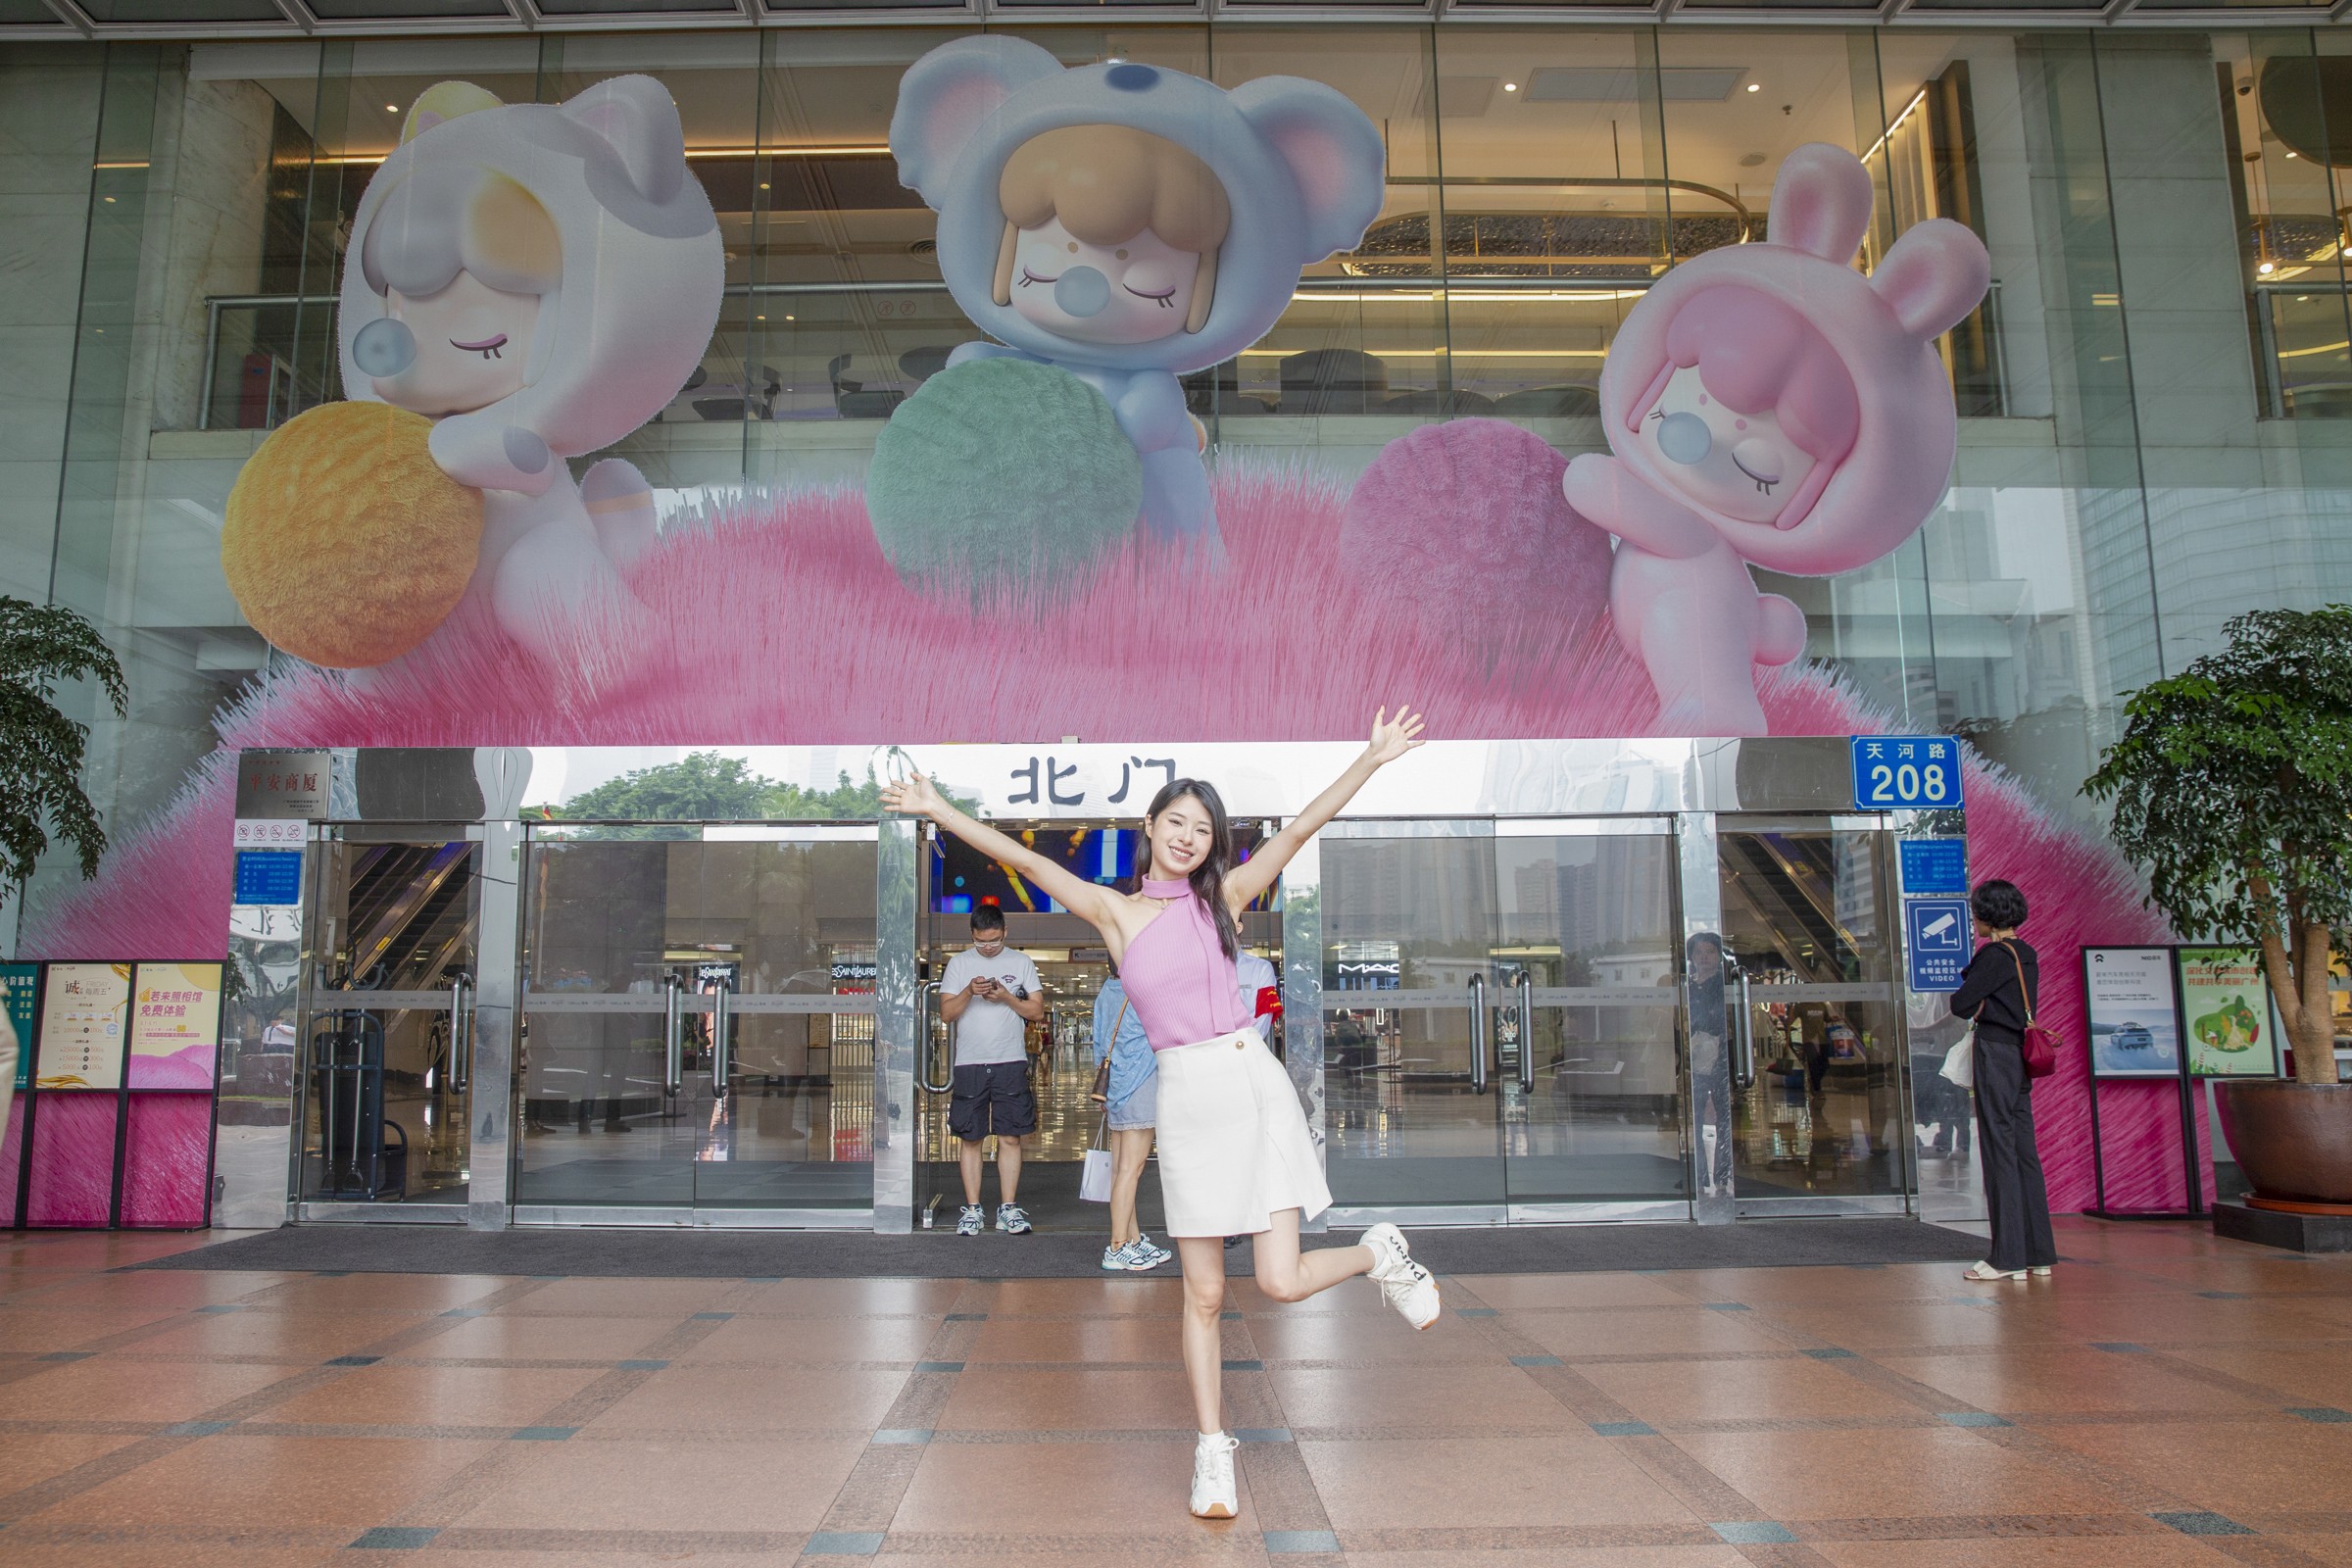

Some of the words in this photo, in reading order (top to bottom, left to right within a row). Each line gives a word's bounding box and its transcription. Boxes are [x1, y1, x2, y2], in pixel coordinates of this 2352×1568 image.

[1866, 743, 1945, 760] 天河路
[249, 772, 318, 793] 平安商厦
[1007, 756, 1176, 806] 北门
[1872, 763, 1946, 802] 208
[85, 987, 107, 996] 每周五
[140, 1004, 187, 1017] 免费体验
